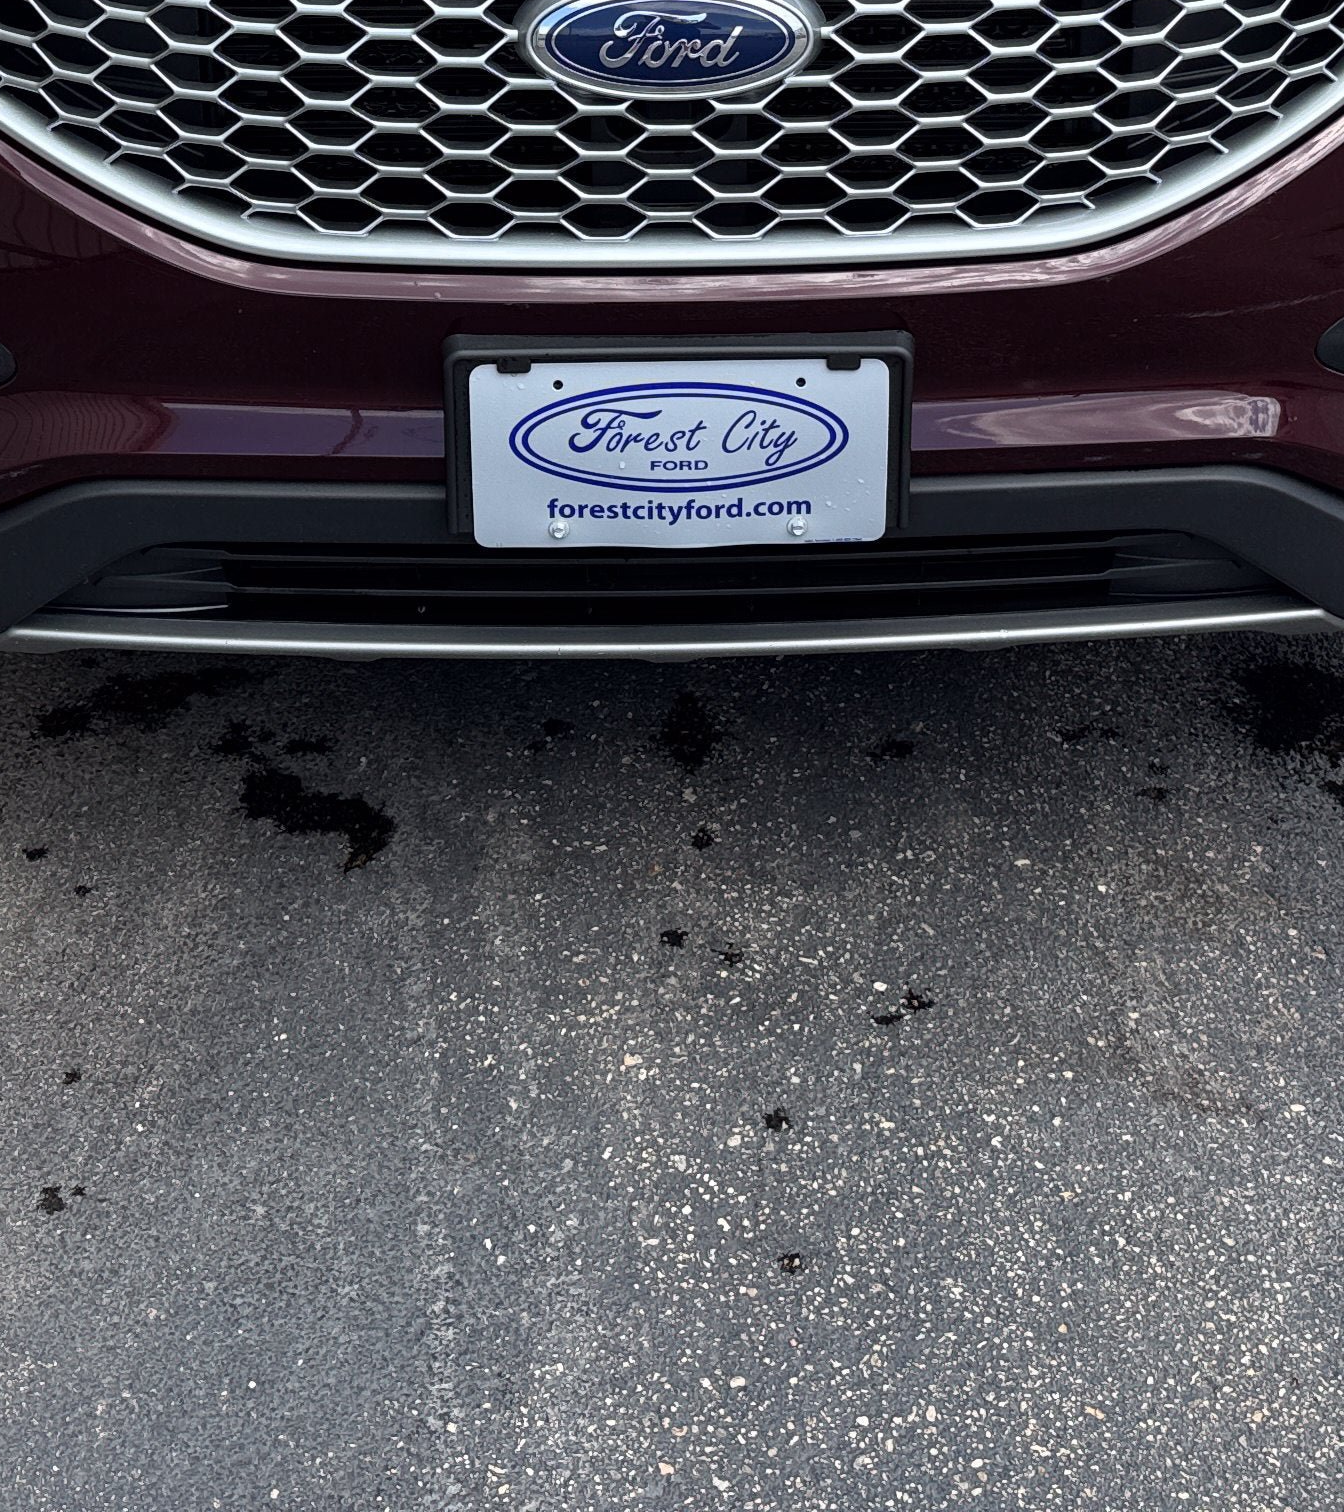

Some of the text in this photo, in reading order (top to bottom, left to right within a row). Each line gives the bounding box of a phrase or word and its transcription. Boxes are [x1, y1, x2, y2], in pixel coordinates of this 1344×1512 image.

[599, 9, 744, 68] Ford
[568, 408, 799, 467] Forest City
[650, 460, 709, 471] FORD
[547, 497, 812, 526] forestcityford.com
